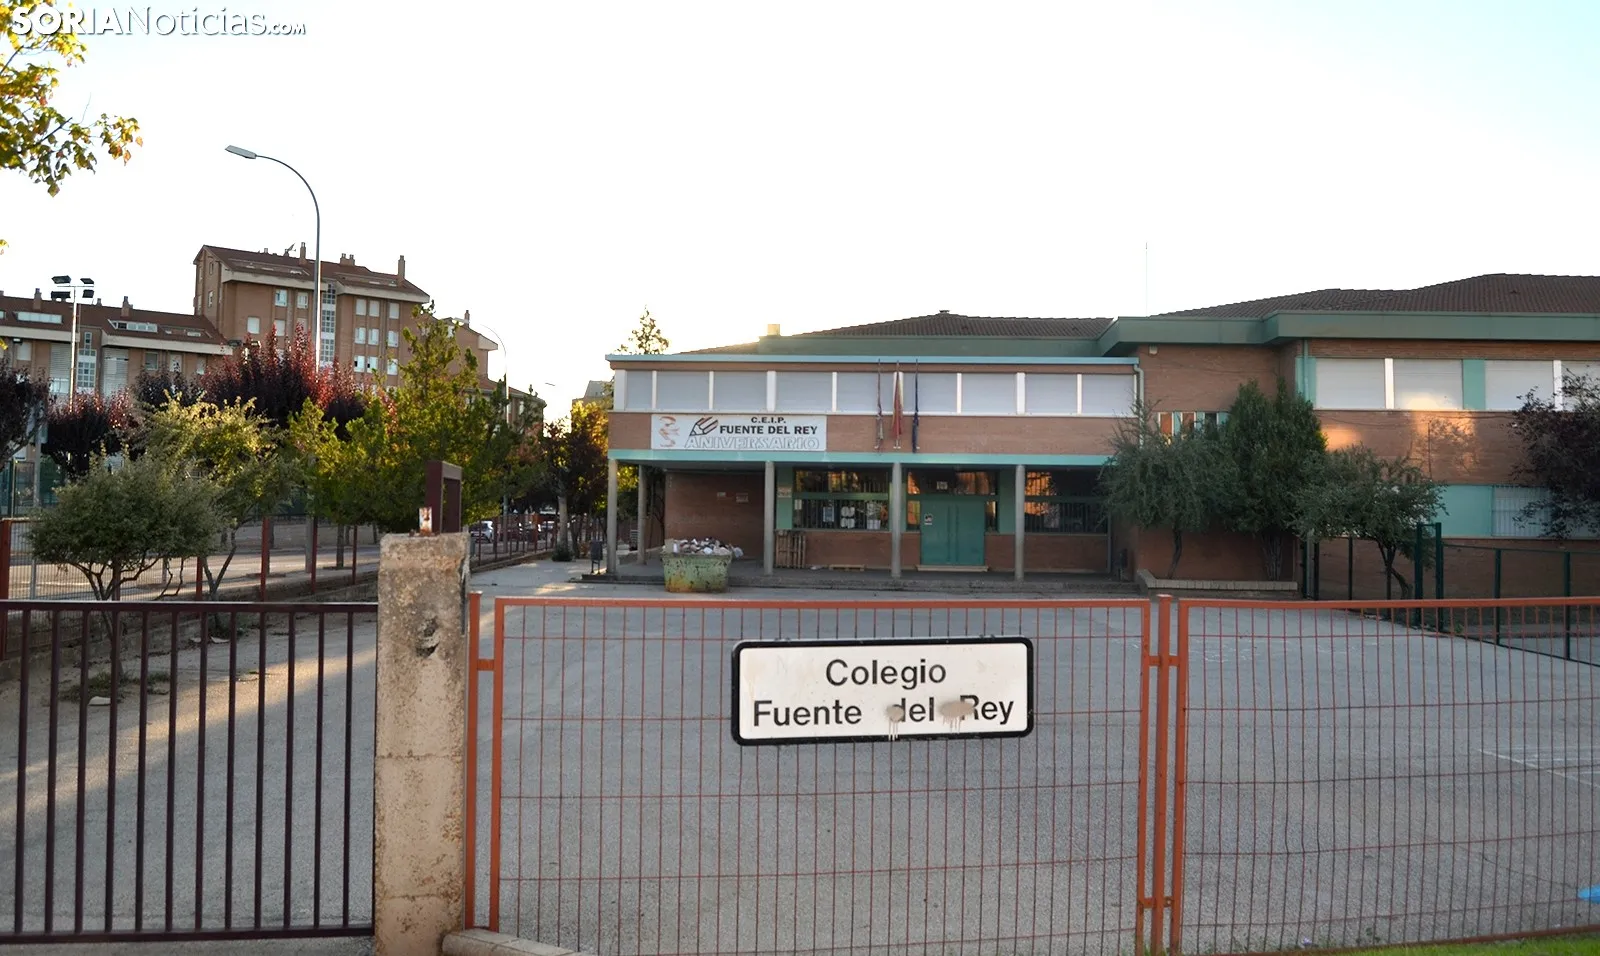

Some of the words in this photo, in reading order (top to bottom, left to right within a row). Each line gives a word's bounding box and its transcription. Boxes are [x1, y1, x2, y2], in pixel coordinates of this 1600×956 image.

[750, 416, 786, 424] C.E.I.P.
[719, 425, 764, 435] FUENTE
[768, 425, 790, 435] DEL
[794, 426, 818, 435] REY
[684, 436, 820, 449] ANIVERSARIO
[826, 658, 947, 690] Colegio
[753, 699, 863, 727] Fuente
